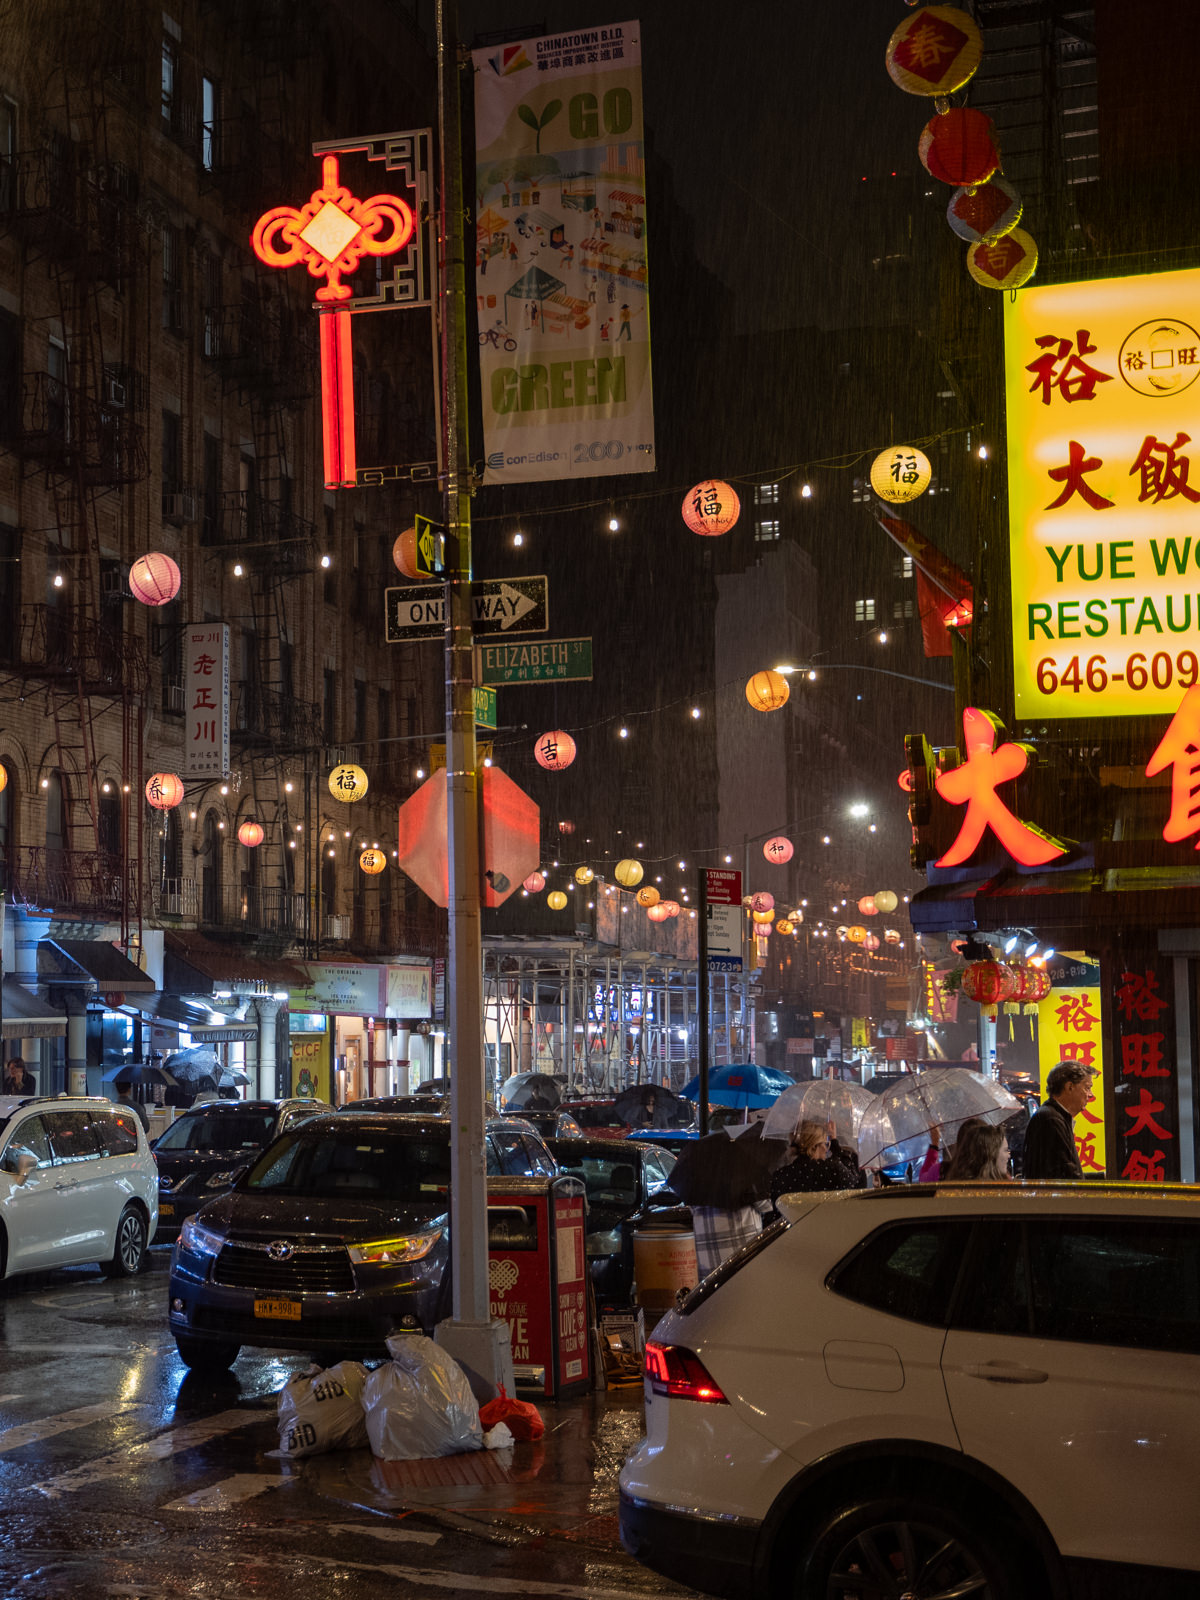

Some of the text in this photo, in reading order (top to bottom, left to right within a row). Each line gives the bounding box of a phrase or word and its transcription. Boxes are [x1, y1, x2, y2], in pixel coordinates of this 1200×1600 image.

[536, 28, 624, 53] CHINATOWN B.I.D.
[537, 40, 624, 59] BUSINESS IMPROVEMENT DISTRICT
[908, 24, 948, 68] 春
[569, 87, 633, 140] GO
[1026, 329, 1114, 406] 裕
[490, 355, 627, 416] GREEN
[574, 440, 625, 464] 200
[890, 454, 920, 485] 福
[692, 487, 722, 518] 福
[1046, 537, 1200, 582] YUE W
[475, 597, 521, 619] WAY
[1028, 594, 1200, 640] RESTAU
[191, 632, 219, 643] 四川
[486, 642, 584, 669] ELIZABETH ST
[193, 654, 217, 743] 老正川
[541, 740, 557, 761] 吉
[336, 769, 357, 791] 福
[362, 852, 374, 867] 福
[709, 872, 736, 880] STANDING
[293, 1043, 320, 1056] CICF
[560, 1309, 577, 1337] LOVE
[313, 1380, 344, 1402] BID
[287, 1423, 317, 1450] BID
